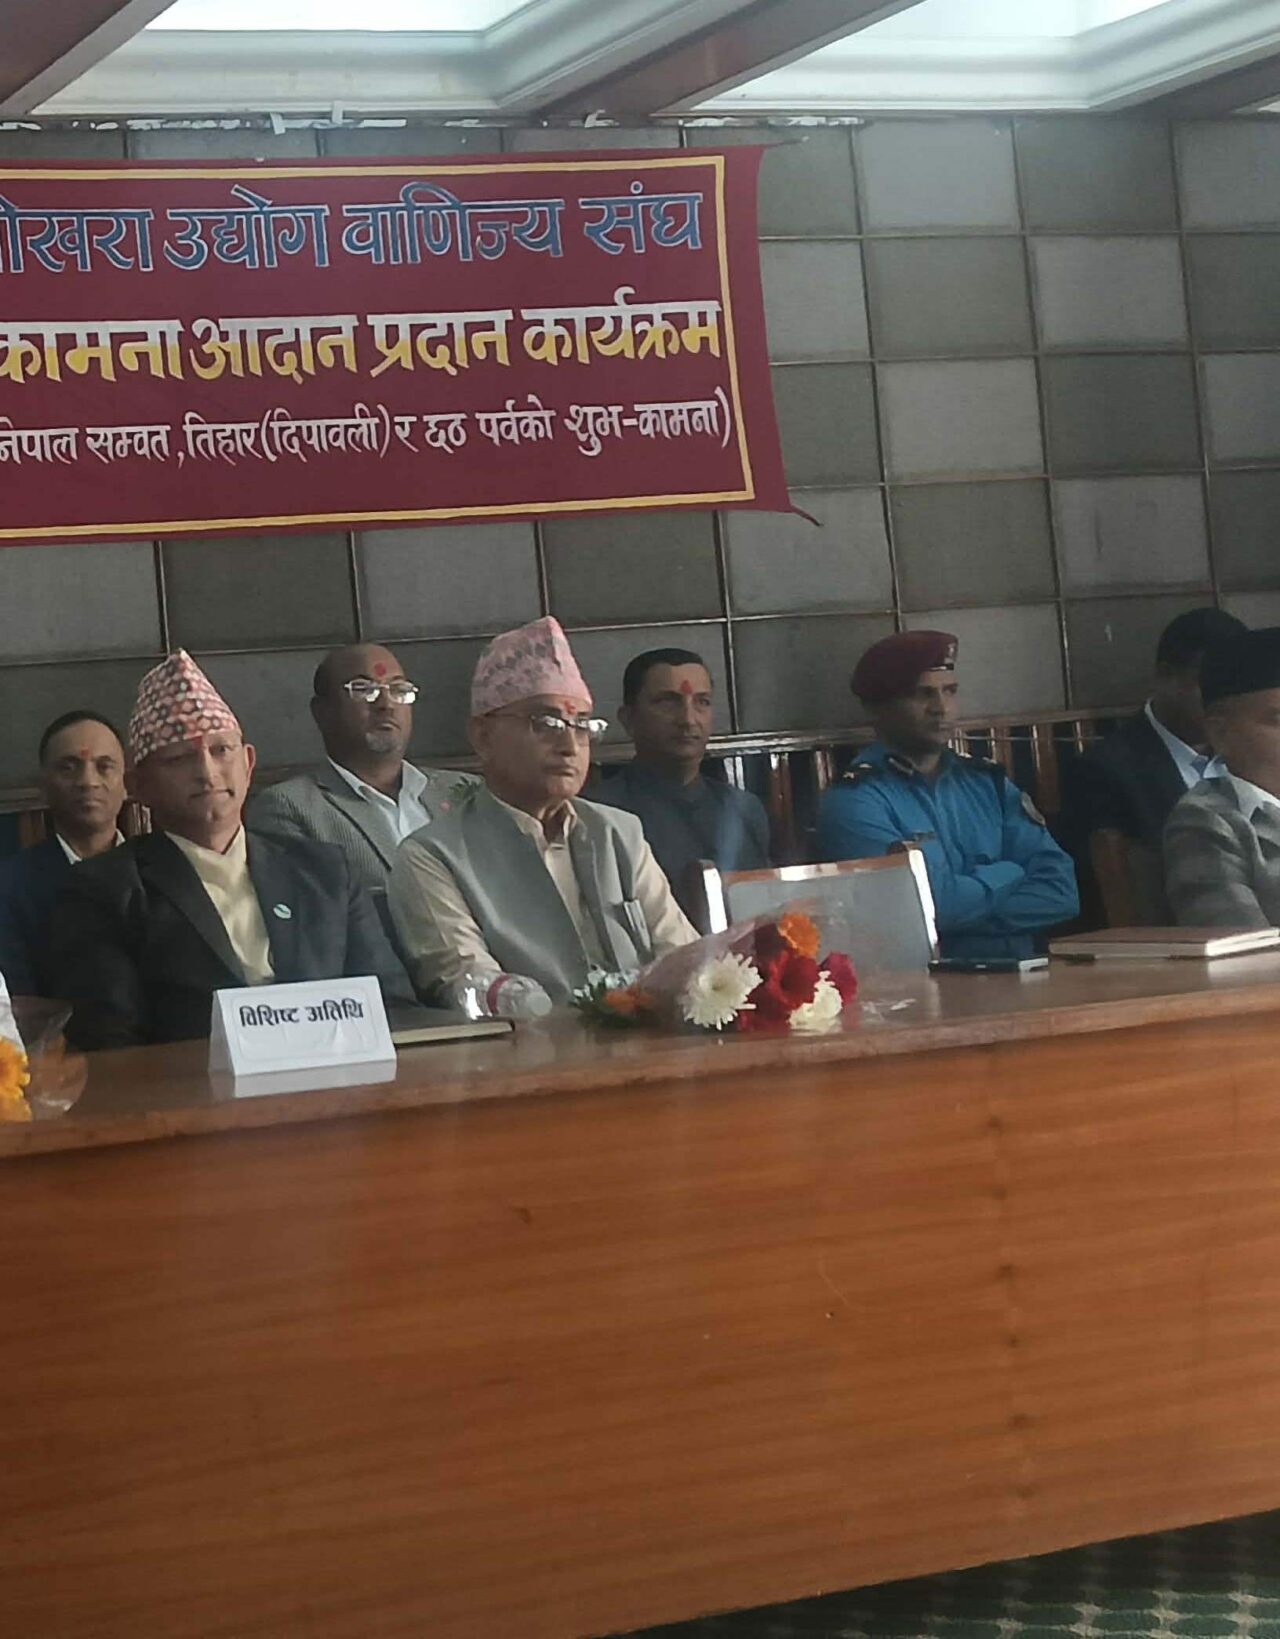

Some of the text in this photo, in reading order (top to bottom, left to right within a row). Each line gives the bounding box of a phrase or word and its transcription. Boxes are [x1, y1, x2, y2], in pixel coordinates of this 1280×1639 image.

[164, 184, 329, 270] उद्योग
[342, 181, 564, 266] वाणिज्य
[578, 181, 703, 254] संघ
[367, 309, 514, 378] प्रदान
[521, 286, 723, 370] कार्यक्रम
[475, 393, 557, 447] पर्वको
[306, 998, 364, 1022] अतिथि
